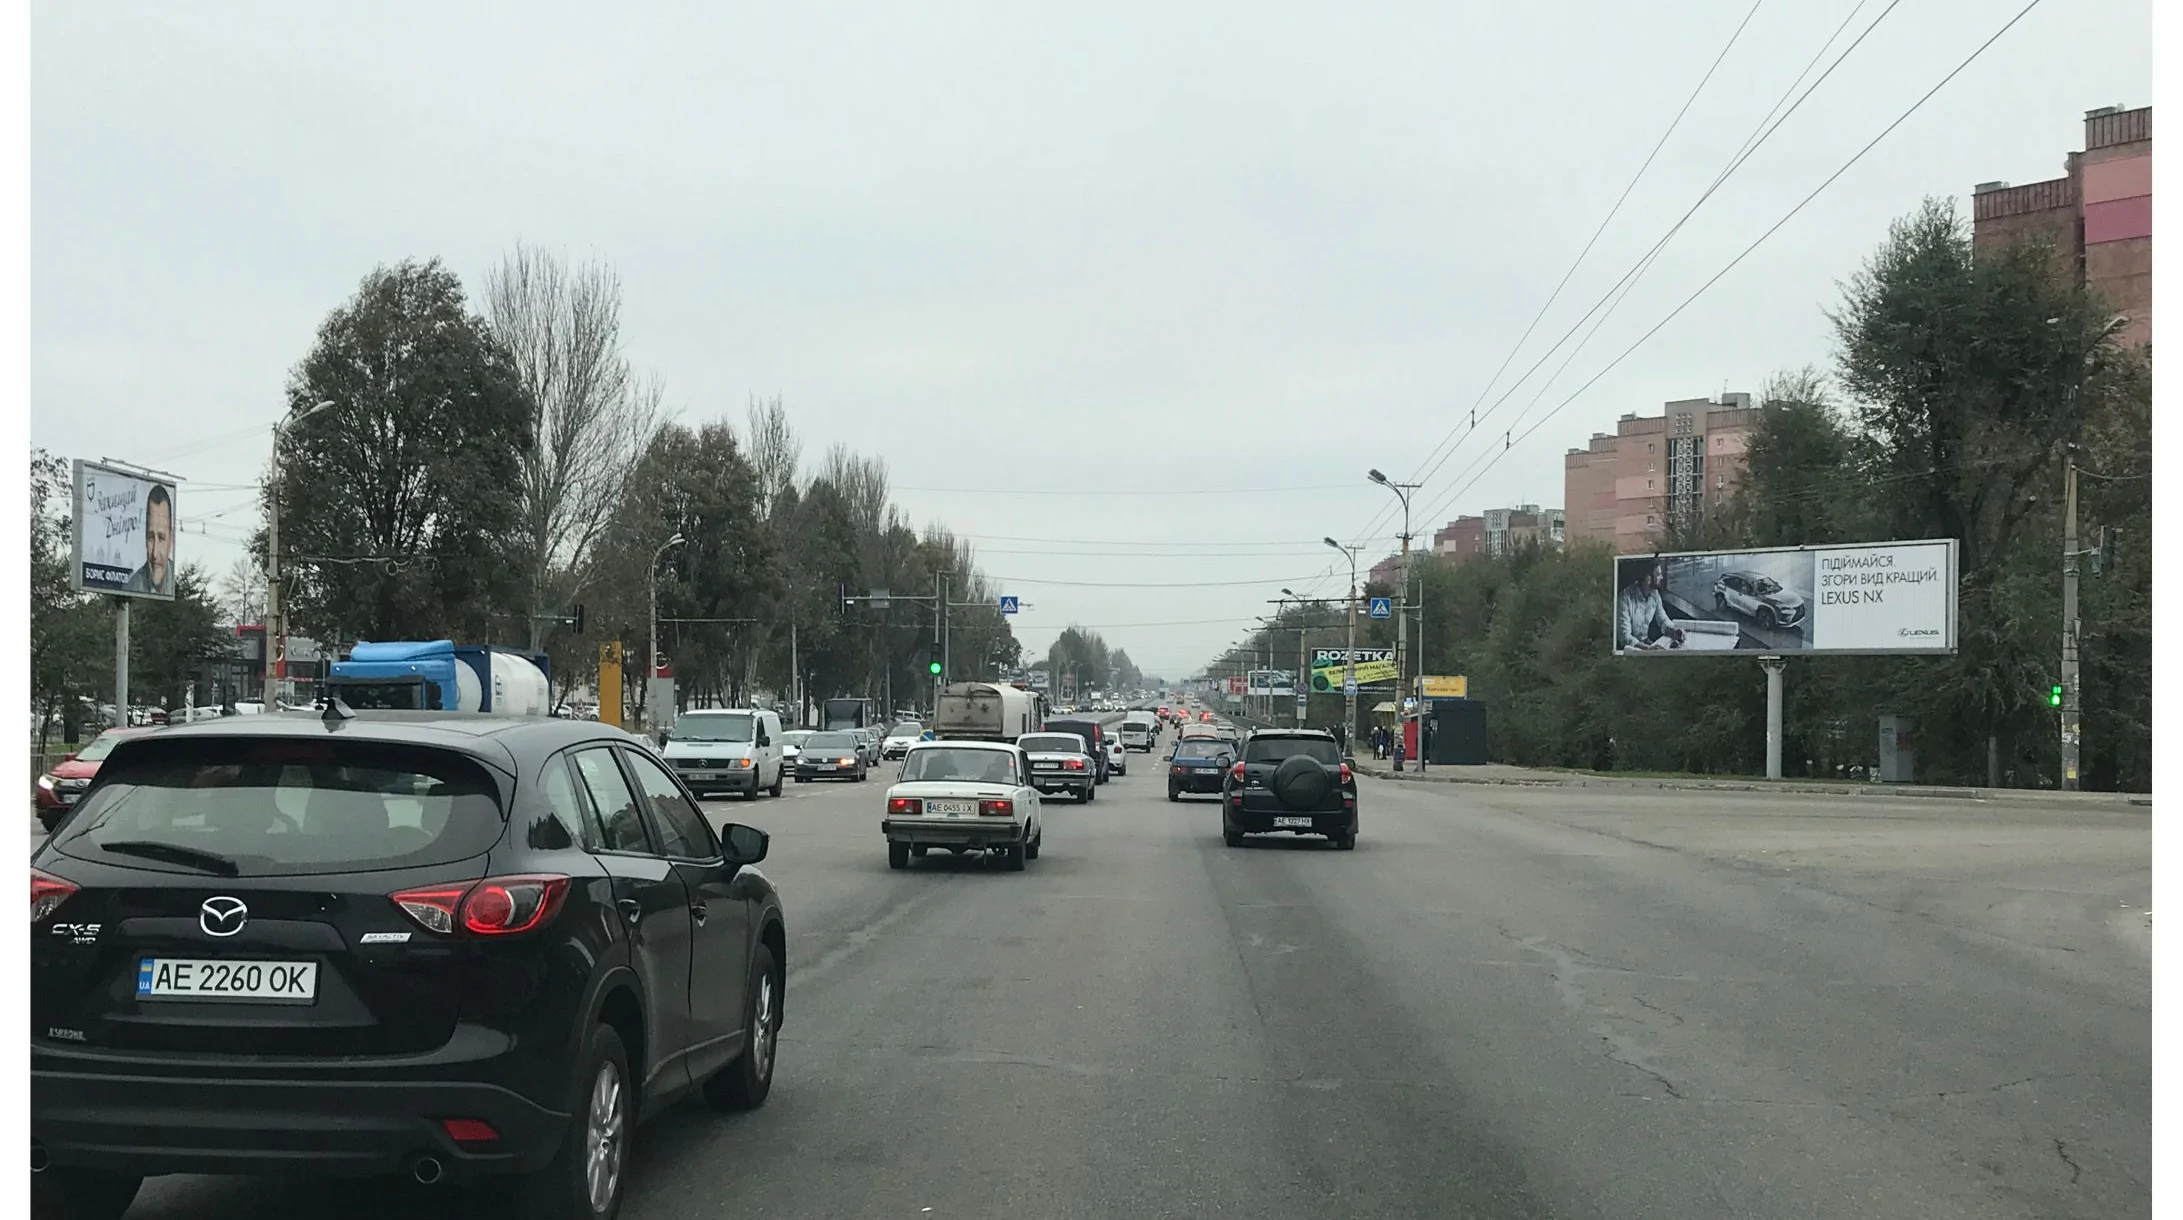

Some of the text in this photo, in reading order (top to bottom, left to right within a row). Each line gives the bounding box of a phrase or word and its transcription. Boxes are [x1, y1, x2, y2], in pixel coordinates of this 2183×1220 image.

[1821, 554, 1896, 571] ПІДІЙМАЙСЯ.
[85, 567, 105, 580] БОРИС
[1821, 567, 1940, 587] ЗГОРИ ВИД КРАЩИЙ.
[1821, 589, 1884, 605] LEXUS NX
[1316, 650, 1394, 661] ROZETKA
[931, 804, 942, 812] AE
[52, 923, 102, 936] CX-5
[68, 936, 96, 945] AWD
[155, 963, 308, 993] AE 2260 OK
[139, 980, 150, 990] UA
